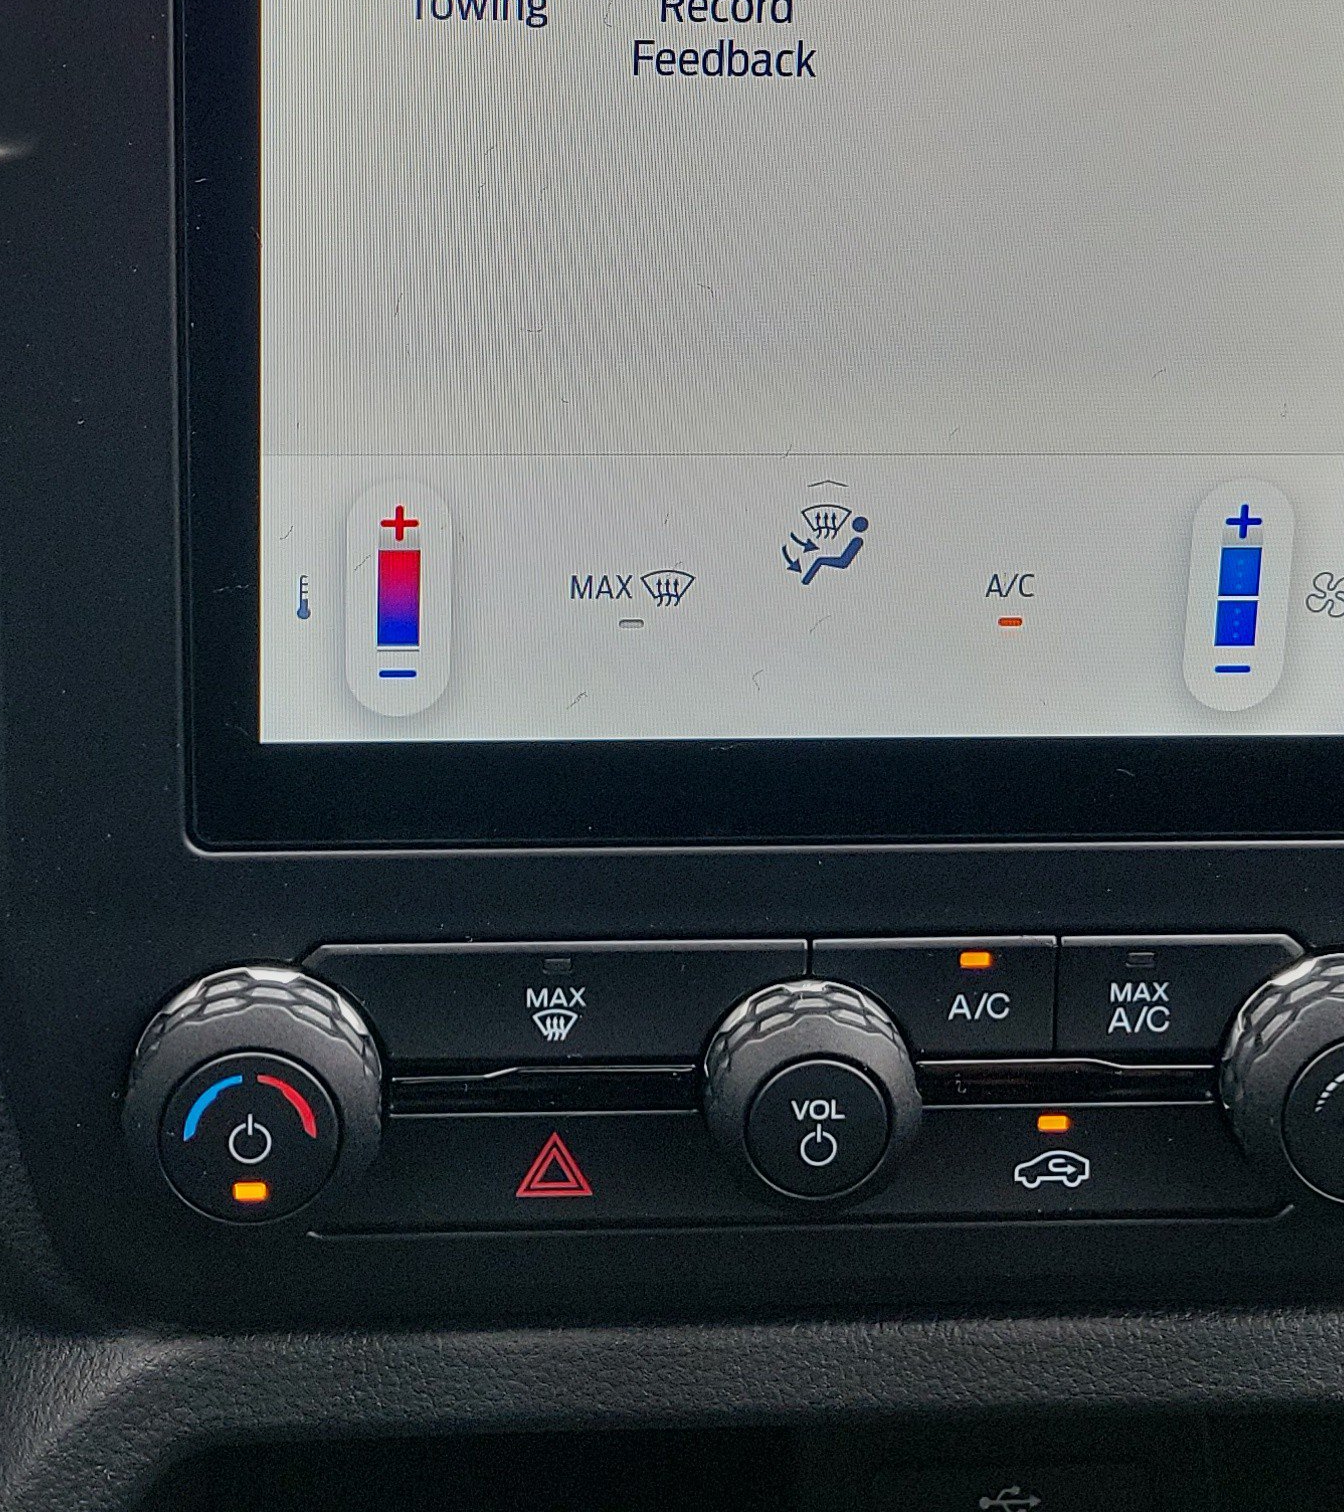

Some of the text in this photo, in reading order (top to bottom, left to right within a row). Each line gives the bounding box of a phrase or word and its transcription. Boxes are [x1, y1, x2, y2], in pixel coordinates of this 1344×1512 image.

[633, 38, 816, 78] Feedback
[570, 574, 633, 600] MAX
[984, 573, 1035, 599] A/C
[526, 987, 587, 1008] MAX
[1109, 982, 1169, 1003] MAX
[948, 992, 1010, 1021] A/C
[1107, 1005, 1170, 1034] A/C
[791, 1099, 846, 1121] VOL
